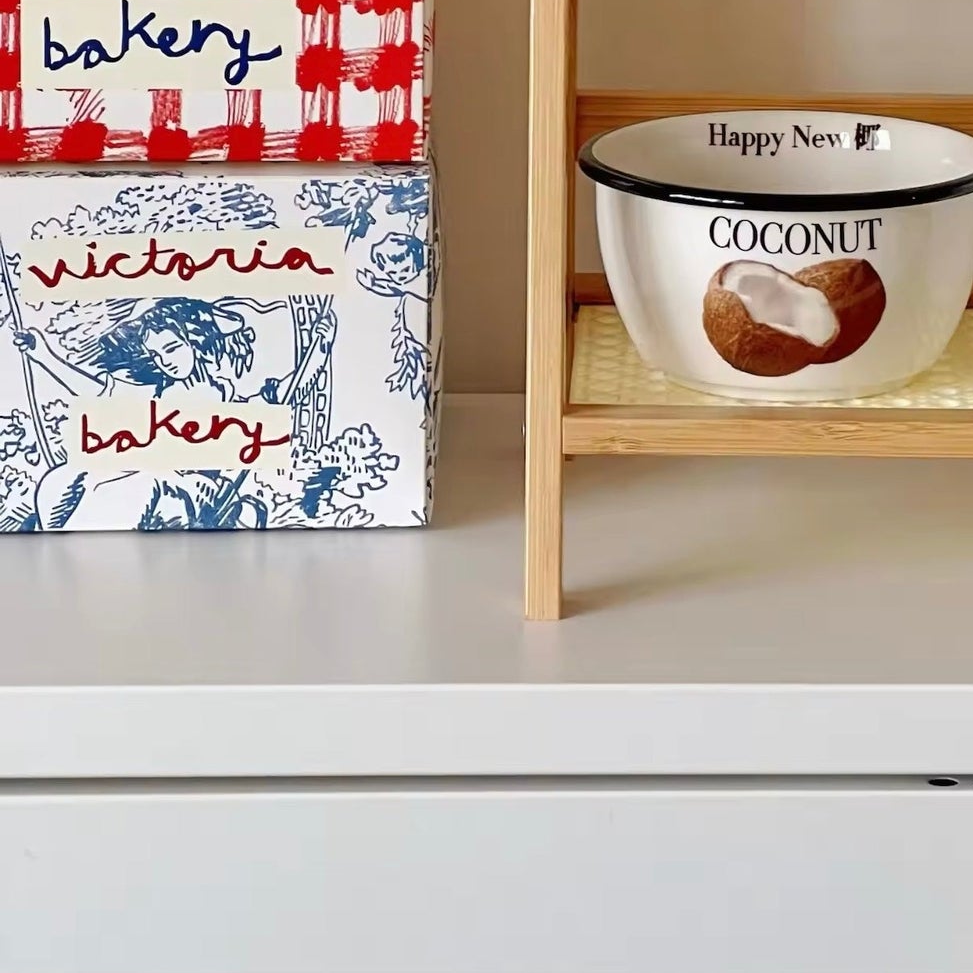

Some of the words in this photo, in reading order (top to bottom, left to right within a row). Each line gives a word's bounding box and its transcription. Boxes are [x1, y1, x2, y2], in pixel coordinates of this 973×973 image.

[708, 122, 785, 156] Happy
[791, 125, 848, 149] New
[708, 214, 883, 256] COCONUT
[27, 238, 335, 288] victoria
[81, 400, 291, 464] bakery
